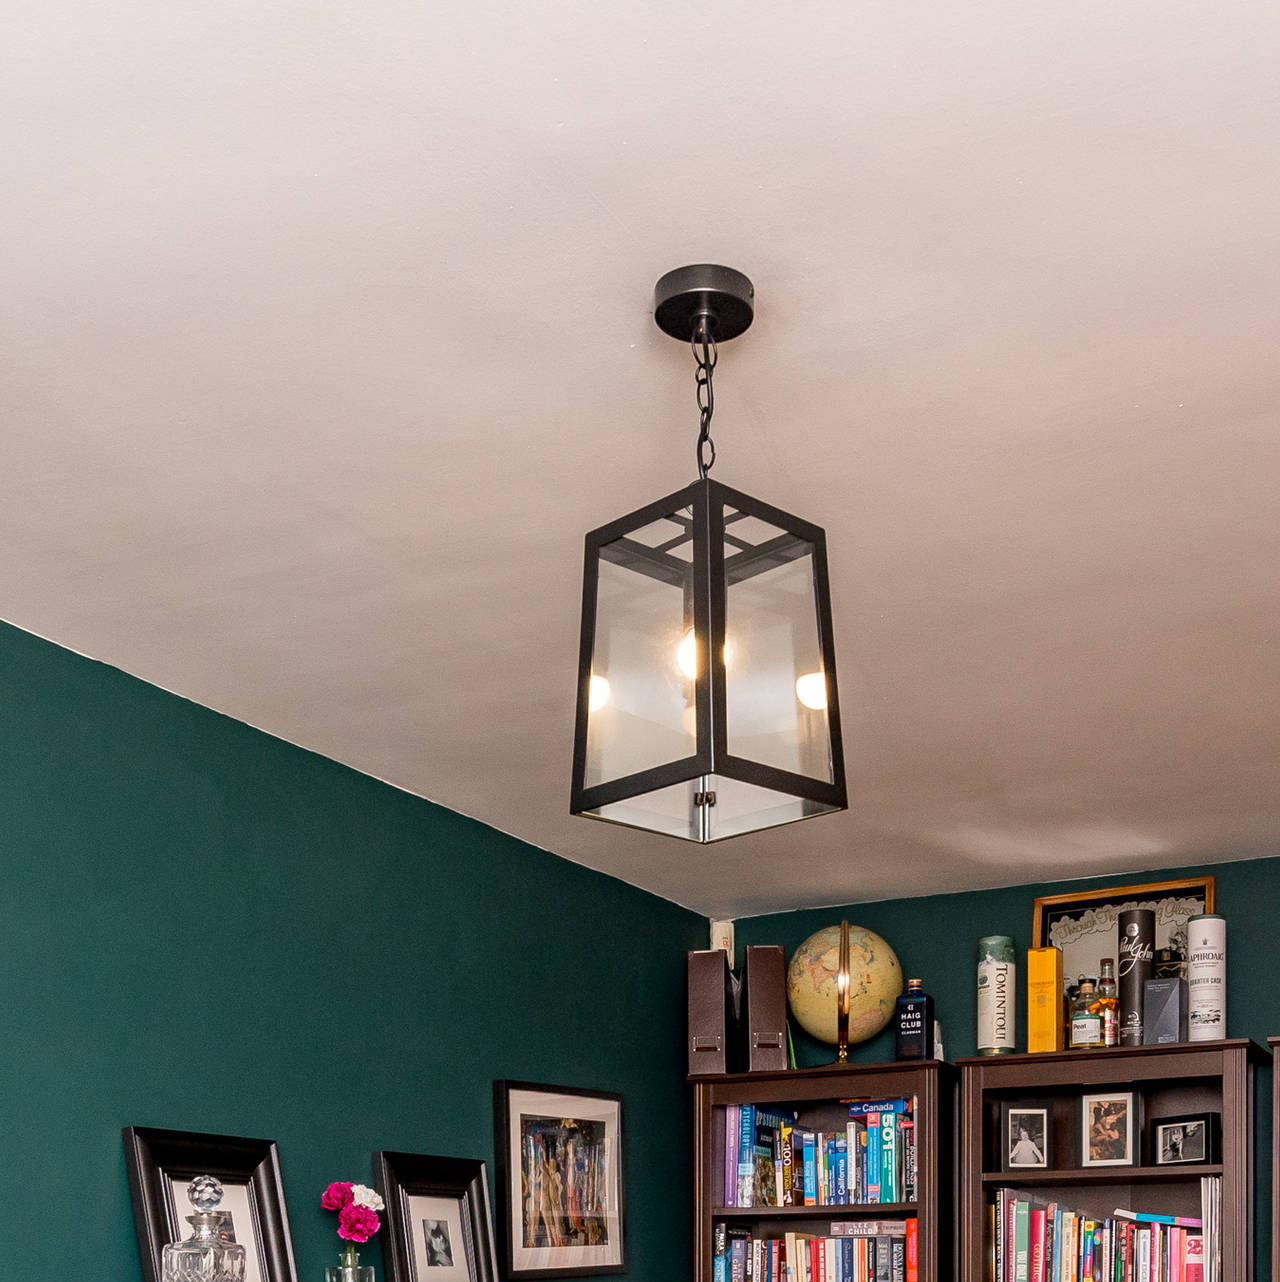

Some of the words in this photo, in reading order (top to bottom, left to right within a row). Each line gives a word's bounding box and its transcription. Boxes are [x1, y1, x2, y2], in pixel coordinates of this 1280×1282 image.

[901, 1012, 921, 1020] HAIG
[901, 1021, 921, 1029] CLUB
[1074, 1022, 1086, 1030] Peat
[862, 1103, 894, 1113] Canada
[742, 1107, 751, 1146] PSYCHOLOGY
[882, 1114, 894, 1150] 501
[783, 1144, 792, 1166] 100
[1046, 1223, 1054, 1261] Architecture
[1033, 1243, 1041, 1280] GOTHIC
